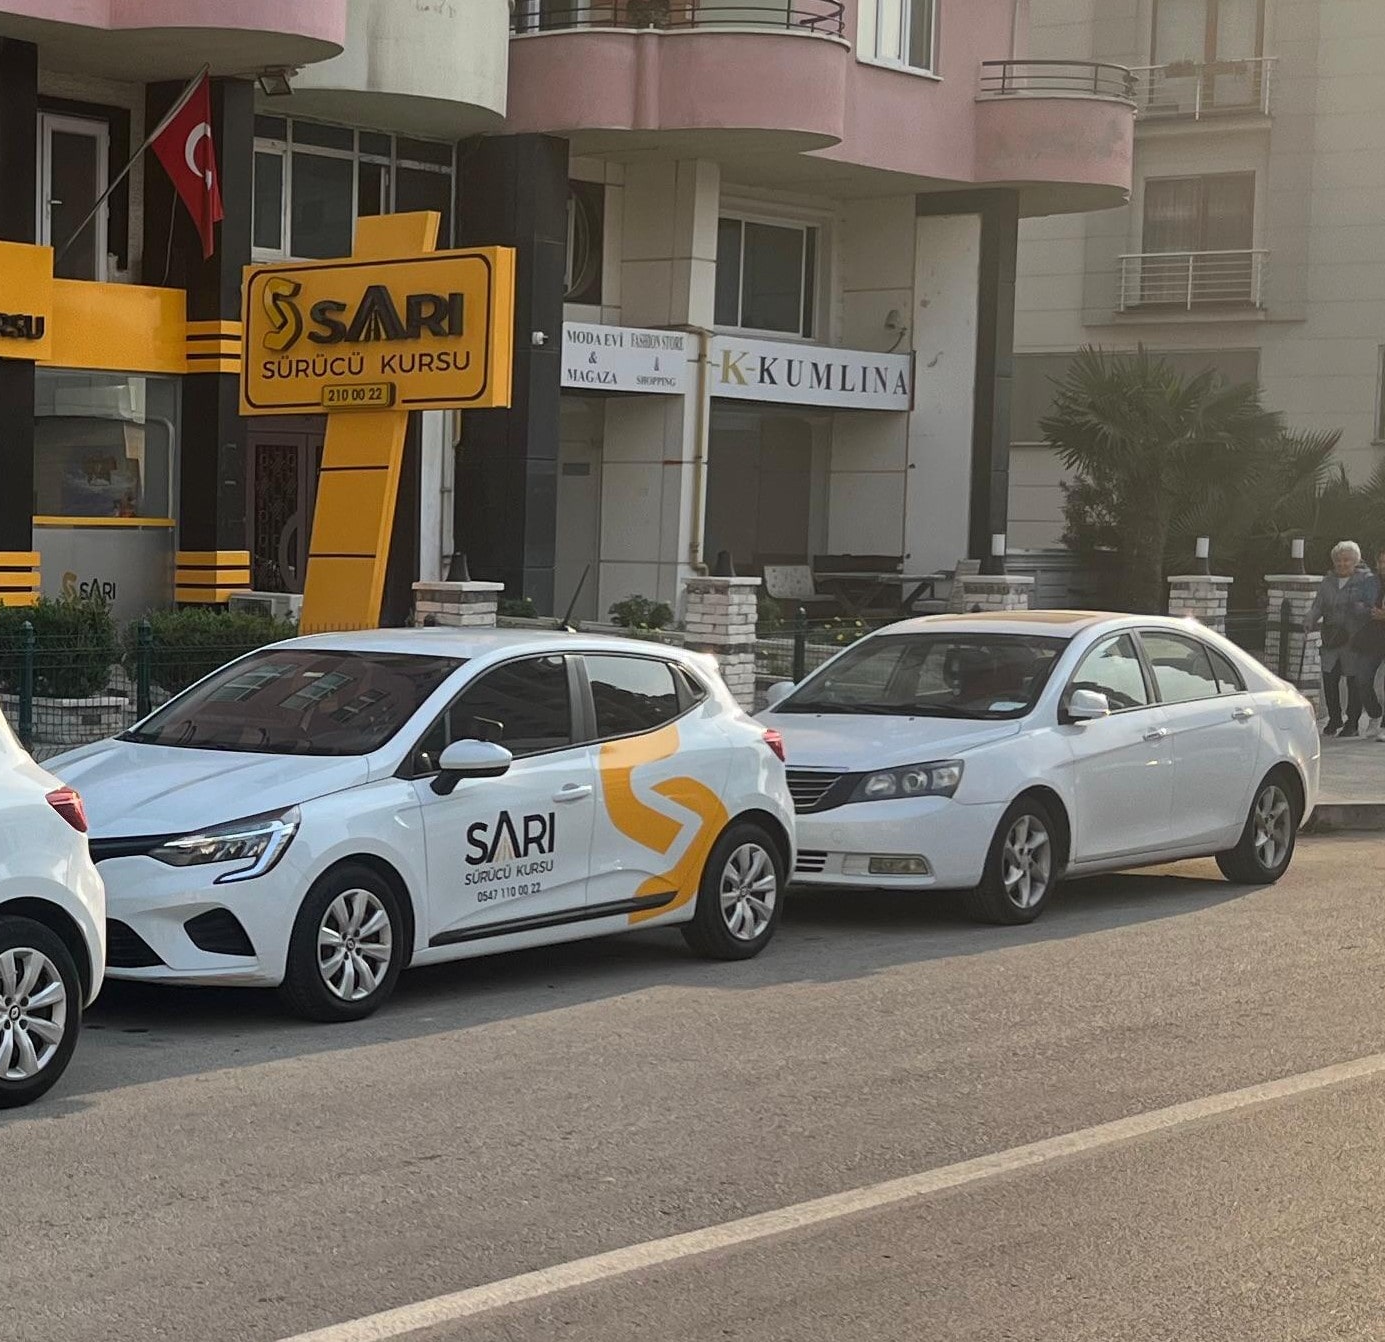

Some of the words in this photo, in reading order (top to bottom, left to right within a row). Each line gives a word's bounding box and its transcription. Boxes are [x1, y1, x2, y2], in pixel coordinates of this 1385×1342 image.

[307, 285, 464, 345] SARI
[567, 330, 601, 346] MODA
[604, 332, 623, 348] EVİ
[262, 352, 364, 379] SÜRÜCÜ
[381, 350, 470, 374] KURSU
[567, 368, 617, 385] MAGAZA
[636, 375, 676, 387] SHOPPING
[329, 389, 348, 401] 210
[352, 388, 365, 400] 00
[369, 388, 382, 400] 22
[465, 810, 555, 866] SARI
[465, 864, 511, 886] SÜRÜCÜ
[516, 860, 554, 877] KURSU
[477, 890, 498, 902] 0547
[501, 887, 516, 899] 110
[518, 884, 529, 896] 00
[531, 882, 541, 893] 22
